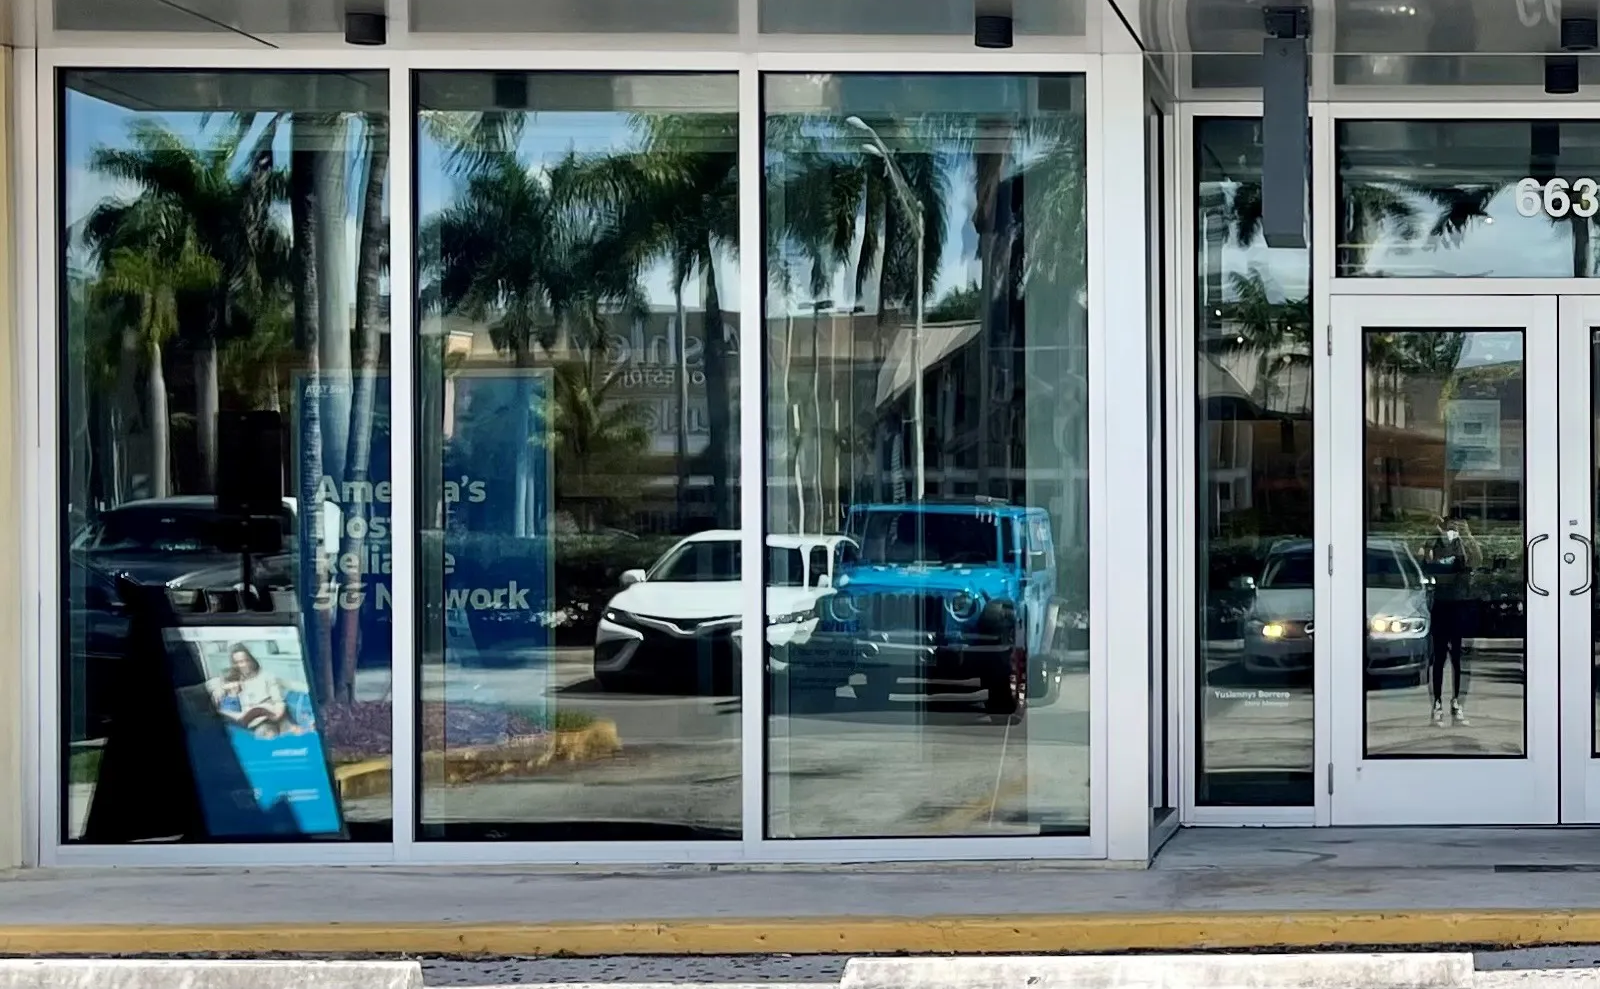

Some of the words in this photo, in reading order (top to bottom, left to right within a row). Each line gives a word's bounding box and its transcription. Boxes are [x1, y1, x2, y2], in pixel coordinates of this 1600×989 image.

[1515, 178, 1599, 217] 663
[315, 475, 487, 503] Amea's
[315, 545, 456, 575] Reliae
[375, 580, 531, 611] Nwork
